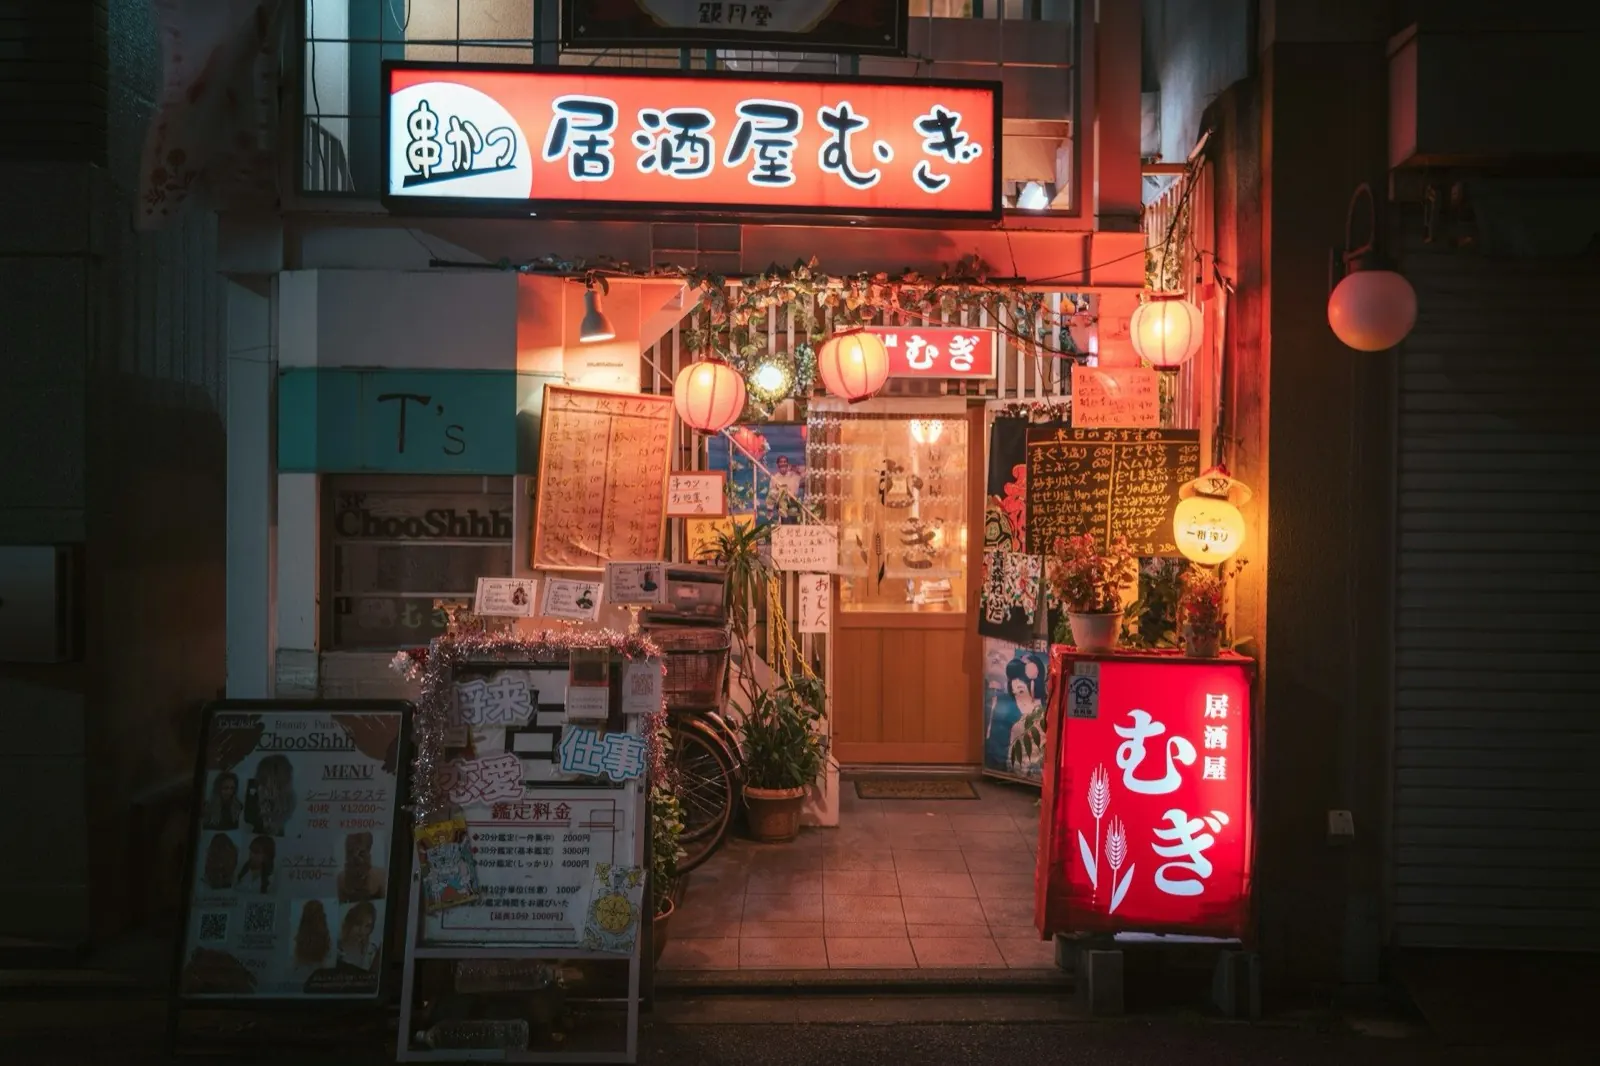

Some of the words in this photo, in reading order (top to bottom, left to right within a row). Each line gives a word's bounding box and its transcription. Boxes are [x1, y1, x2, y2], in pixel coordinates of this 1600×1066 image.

[405, 99, 517, 179] 串かつ
[904, 334, 981, 372] むぎ
[377, 393, 466, 455] T's
[1054, 428, 1162, 441] 本日のおすすめ
[1117, 456, 1168, 470] ハムカツ
[334, 508, 512, 538] ChooShhh
[815, 577, 829, 627] おでん
[258, 732, 355, 750] ChooShhh
[1203, 693, 1229, 780] 居酒屋
[560, 727, 645, 781] 仕事
[322, 764, 375, 778] MENU
[491, 802, 572, 821] 鑑定料金
[1113, 709, 1230, 896] むぎ
[562, 833, 591, 843] 2000円
[562, 846, 590, 856] 3000円
[561, 859, 590, 869] 4000円
